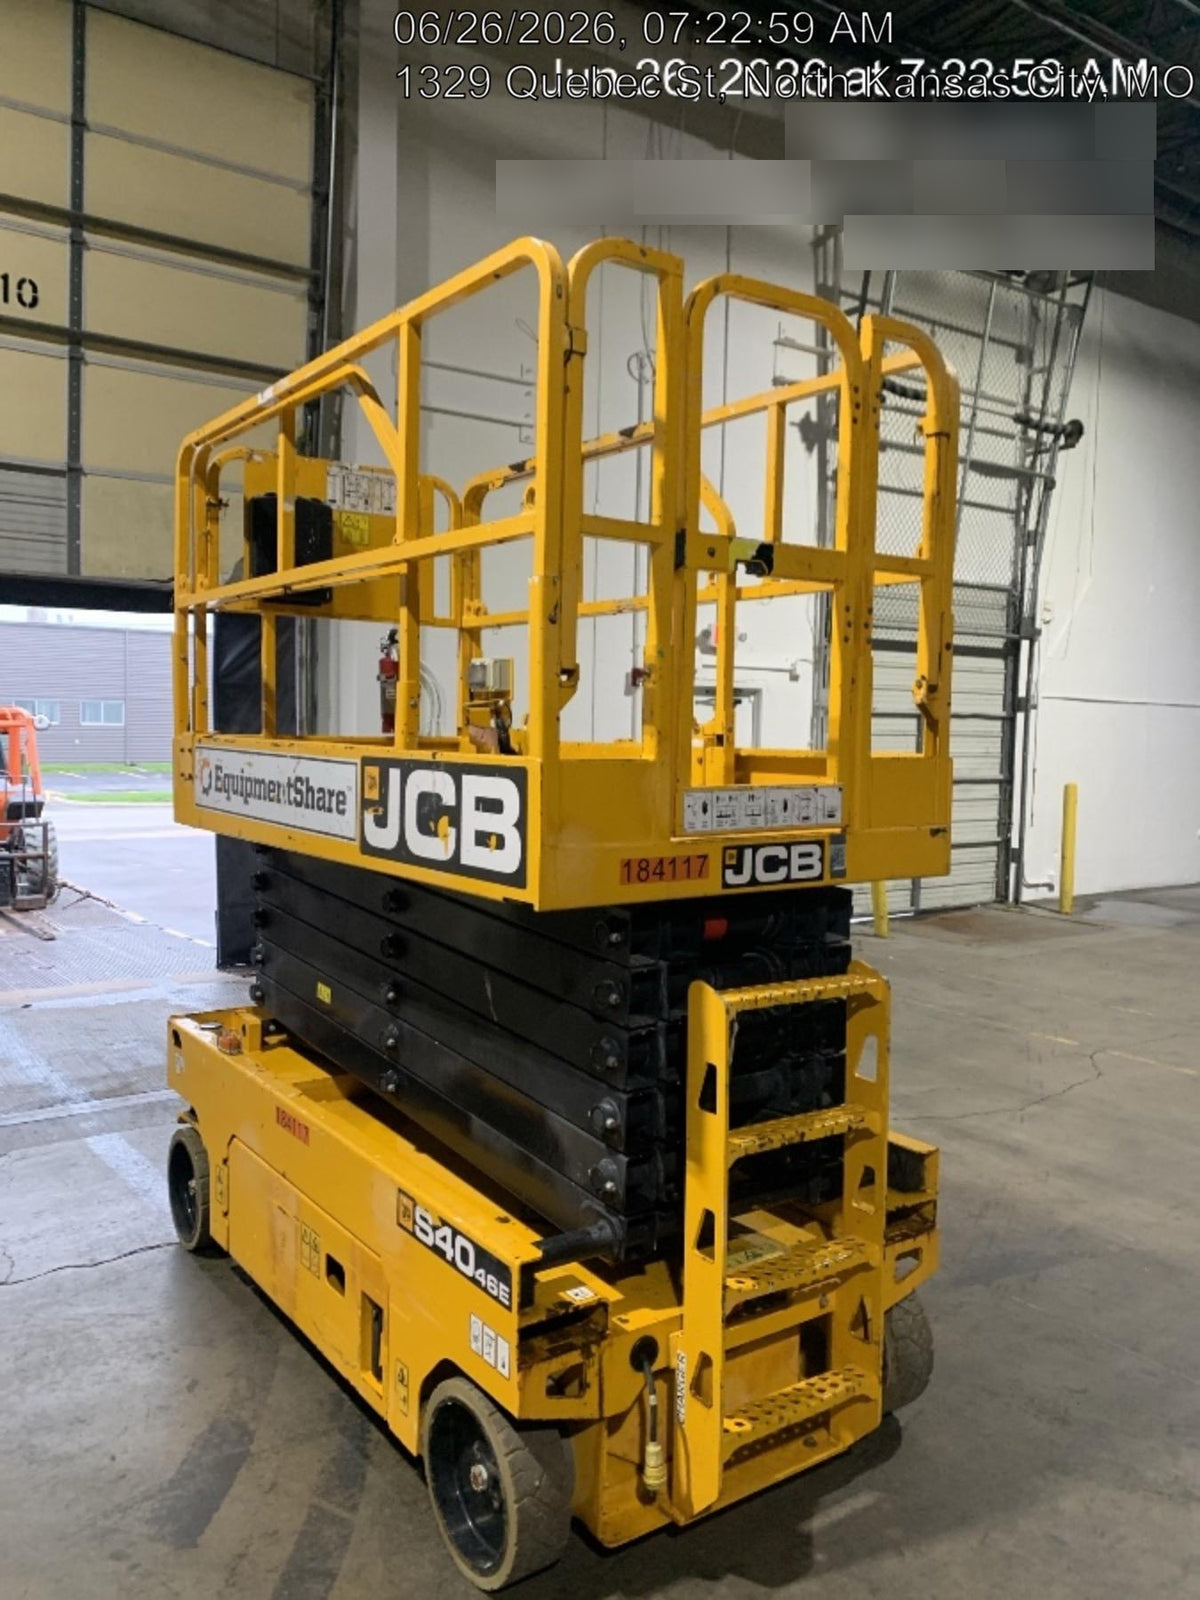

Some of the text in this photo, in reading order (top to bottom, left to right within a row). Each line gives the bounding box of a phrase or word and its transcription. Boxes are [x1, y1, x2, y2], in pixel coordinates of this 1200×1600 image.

[0, 272, 39, 309] 10
[214, 763, 347, 816] EquipmentShare
[362, 766, 523, 874] JCB
[623, 854, 710, 884] 184117
[723, 843, 823, 886] JCB
